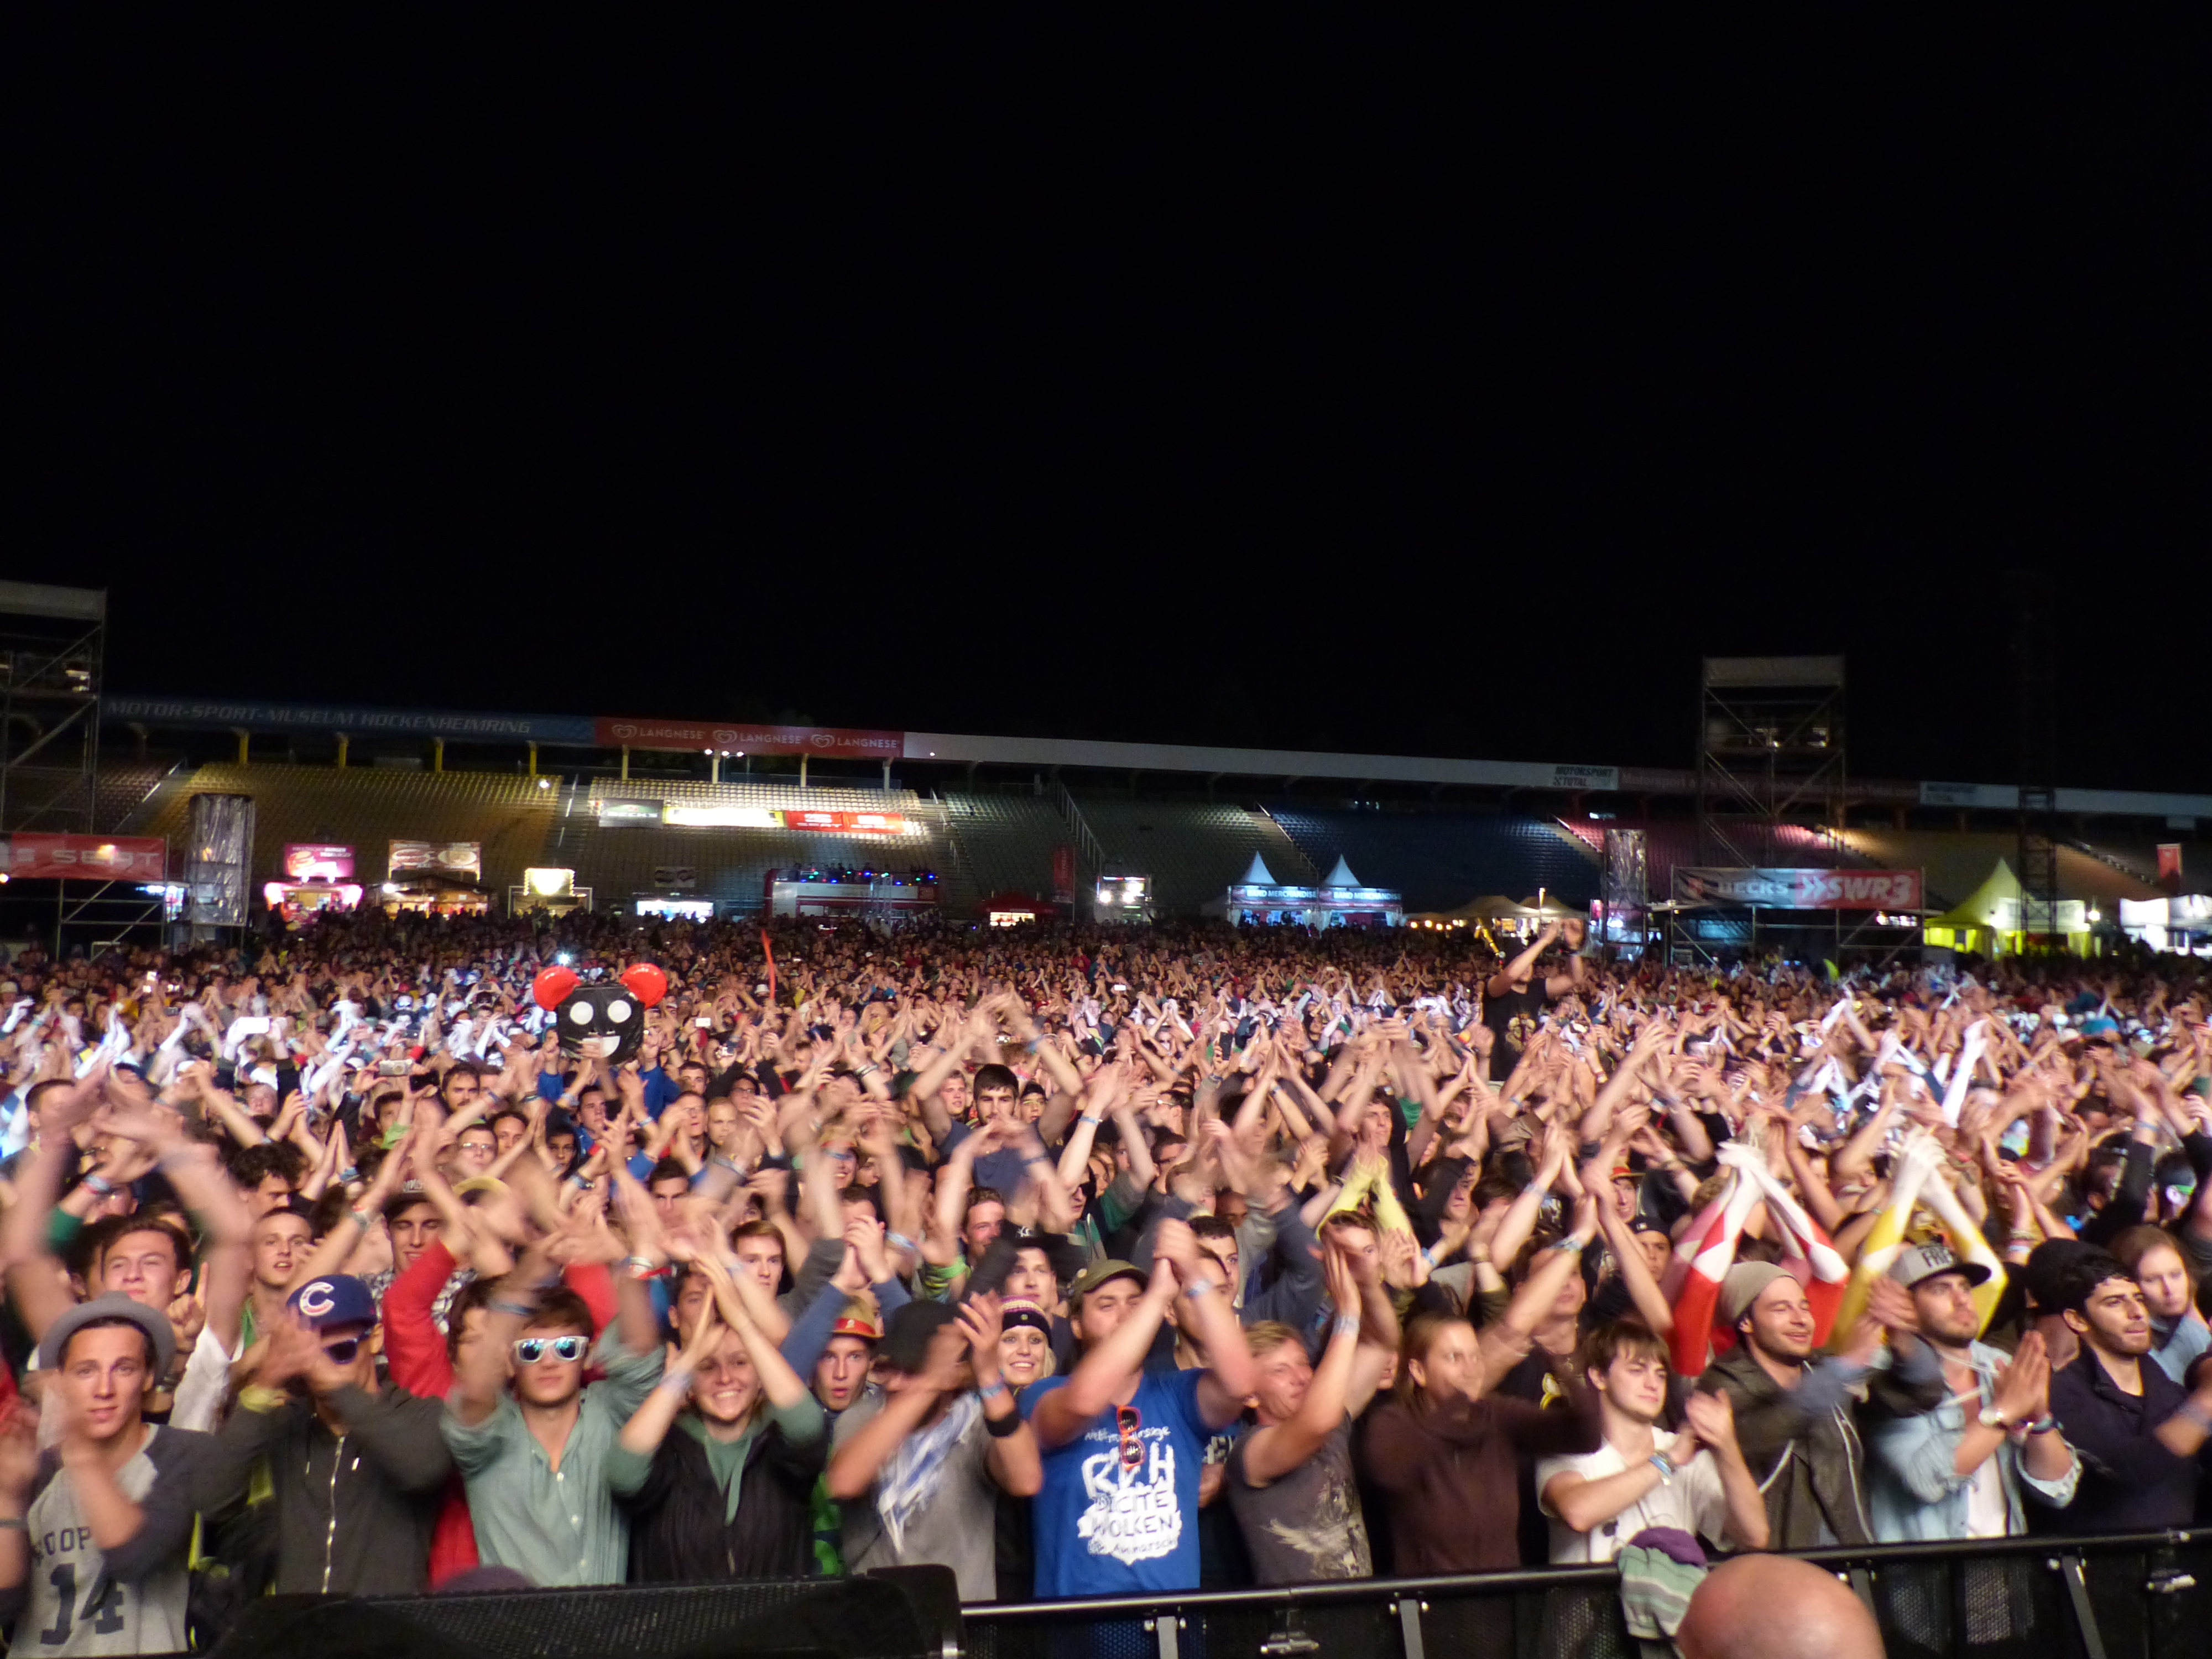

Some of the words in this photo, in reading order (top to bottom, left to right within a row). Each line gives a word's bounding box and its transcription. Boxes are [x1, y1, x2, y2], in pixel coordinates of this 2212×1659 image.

[361, 712, 531, 734] HOCKENHEIMRING
[640, 727, 703, 740] LANGNESE
[740, 734, 802, 745] LANGNESE
[837, 737, 898, 748] LANGNESE
[1268, 890, 1317, 899] MERCHANDISE
[1826, 874, 1914, 905] SWR3
[40, 1563, 125, 1646] 14
